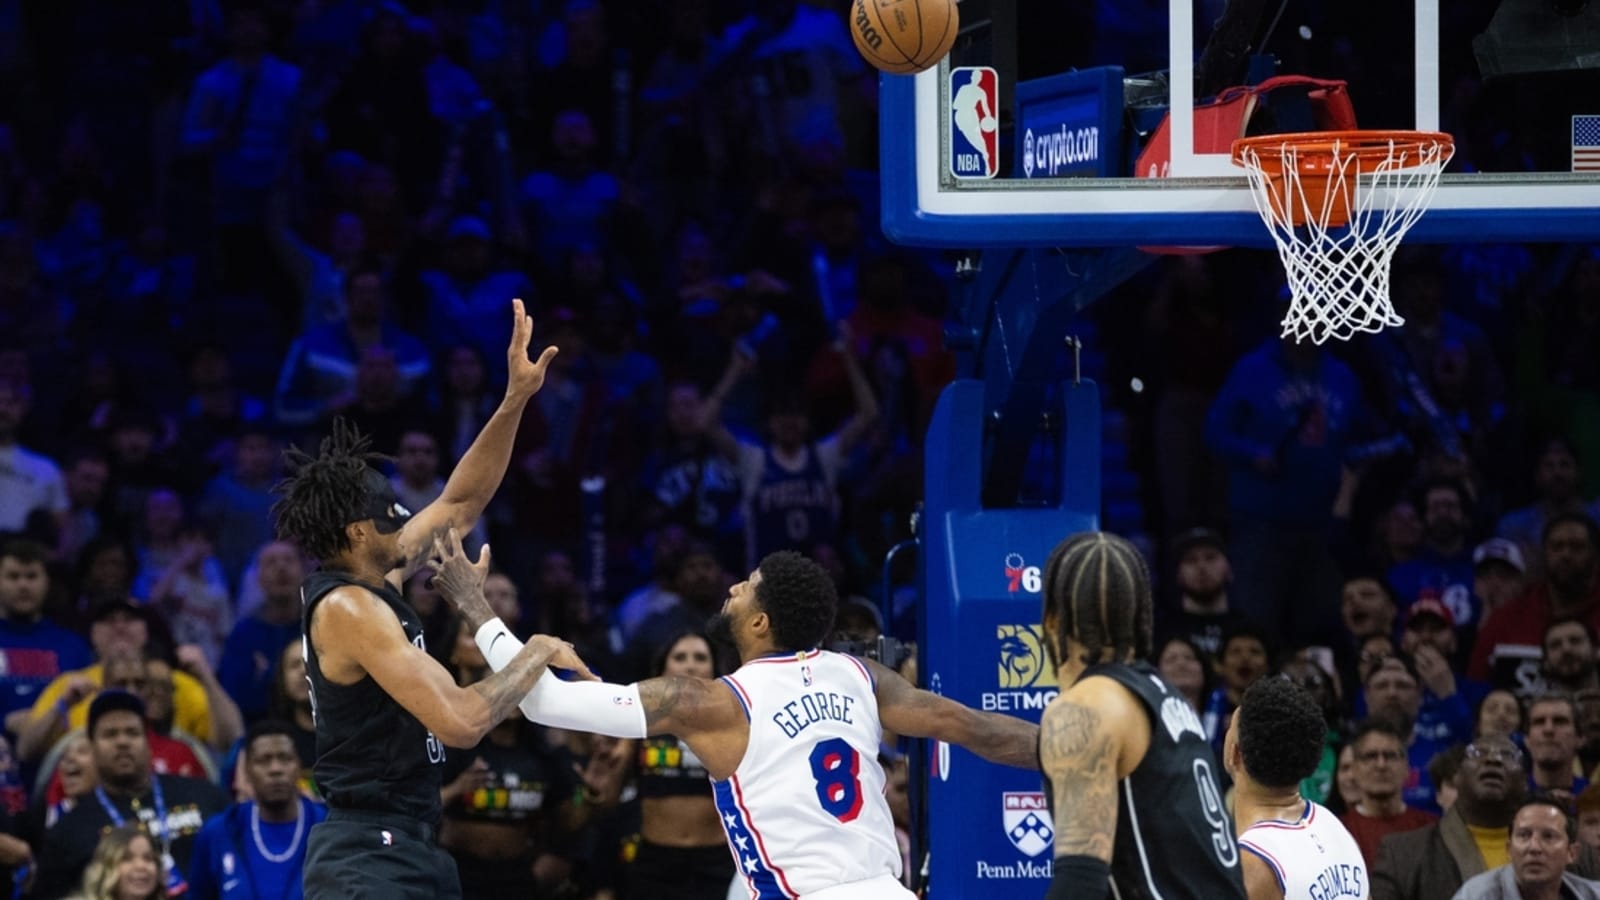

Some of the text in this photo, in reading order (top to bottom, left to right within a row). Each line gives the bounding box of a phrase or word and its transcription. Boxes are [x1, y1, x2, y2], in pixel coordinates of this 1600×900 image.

[957, 154, 980, 171] NBA
[1004, 565, 1042, 593] 76
[773, 692, 854, 739] GEORGE
[808, 737, 864, 824] 8
[1193, 758, 1238, 868] 9
[977, 861, 1015, 878] Penn
[1309, 864, 1362, 900] GRIMES
